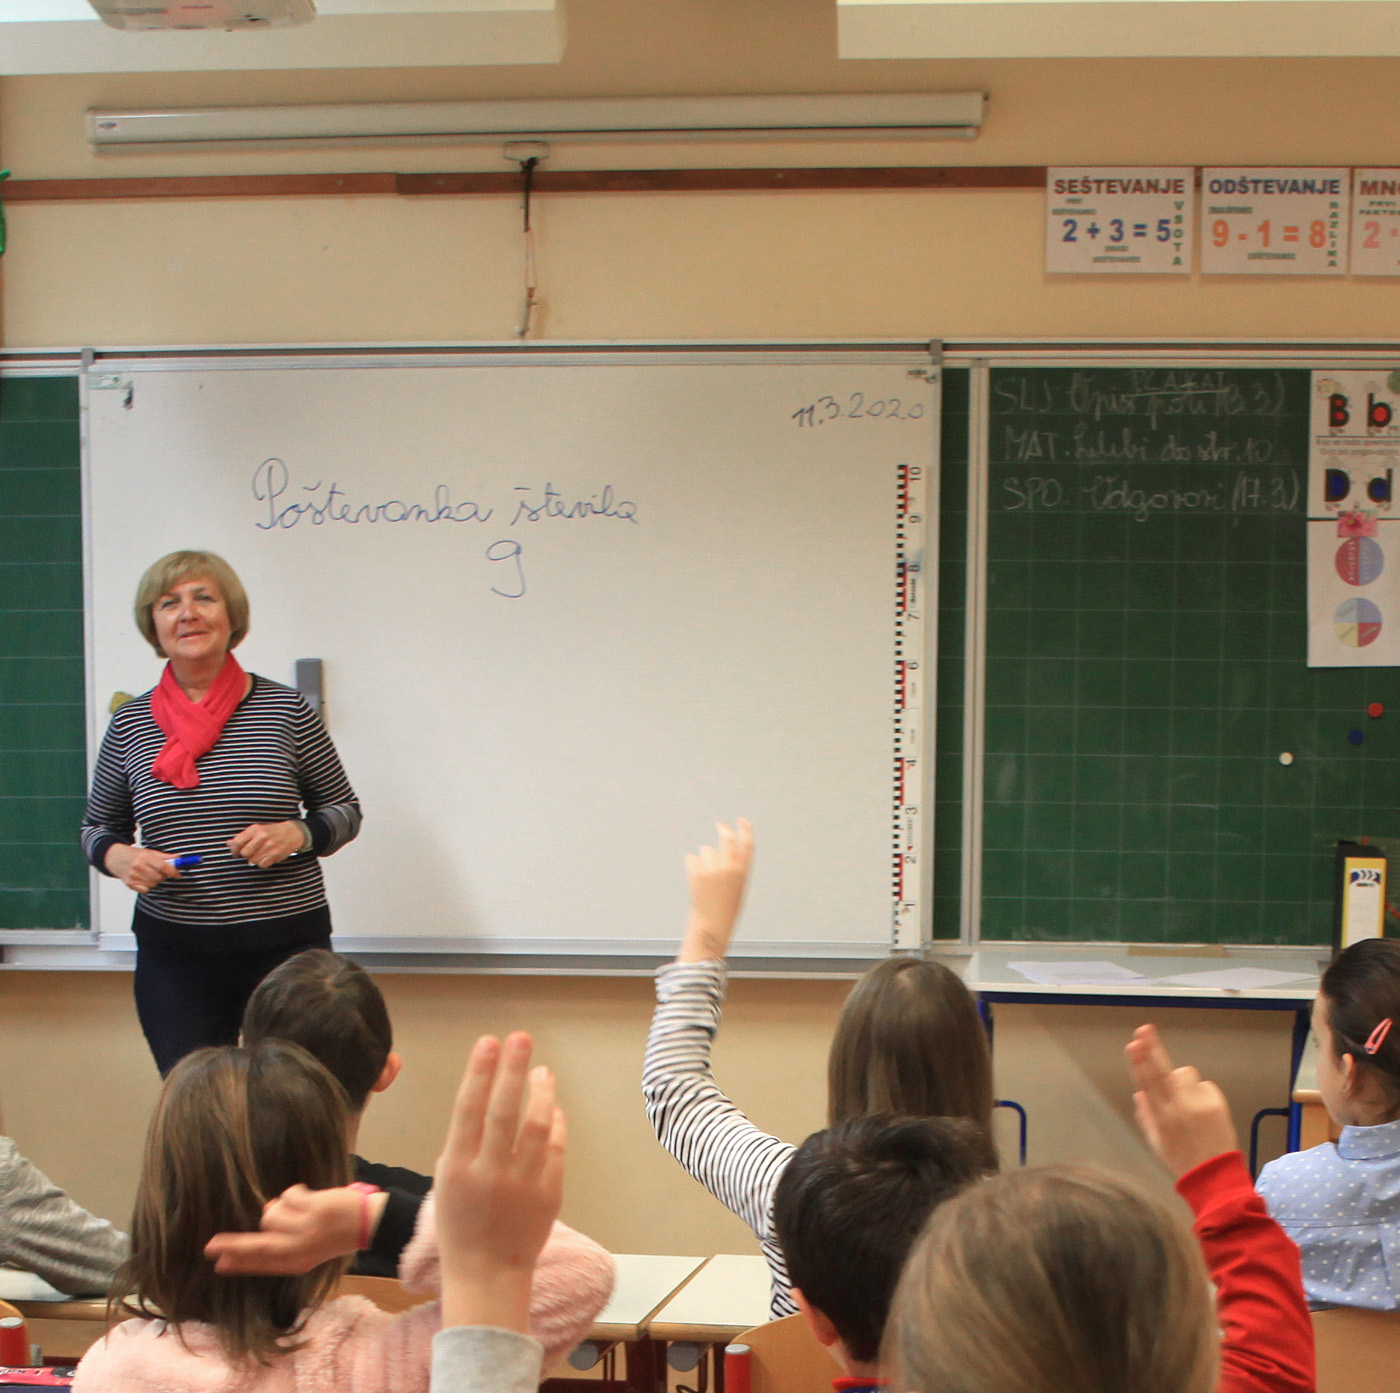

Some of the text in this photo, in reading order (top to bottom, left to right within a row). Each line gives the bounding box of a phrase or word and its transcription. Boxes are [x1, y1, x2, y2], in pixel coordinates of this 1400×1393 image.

[1054, 176, 1185, 194] SEŠTEVANJE
[1209, 176, 1340, 194] ODŠTEVANJE
[1063, 219, 1077, 242] 2
[1110, 219, 1124, 242] 3
[1156, 219, 1171, 242] 5
[1212, 220, 1229, 247] 9
[1257, 220, 1271, 247] 1
[1309, 220, 1326, 248] 8
[1363, 221, 1380, 248] 2
[1328, 393, 1392, 427] B b
[908, 466, 922, 481] 10
[253, 457, 639, 530] Poštevanka števila
[1324, 468, 1350, 502] D
[1367, 468, 1392, 503] d
[908, 514, 922, 524] 9
[485, 539, 526, 598] 9
[908, 564, 921, 573] 8
[907, 612, 920, 621] 7
[906, 661, 919, 670] 6
[905, 758, 918, 768] 4
[905, 806, 918, 815] 3
[904, 855, 917, 864] 2
